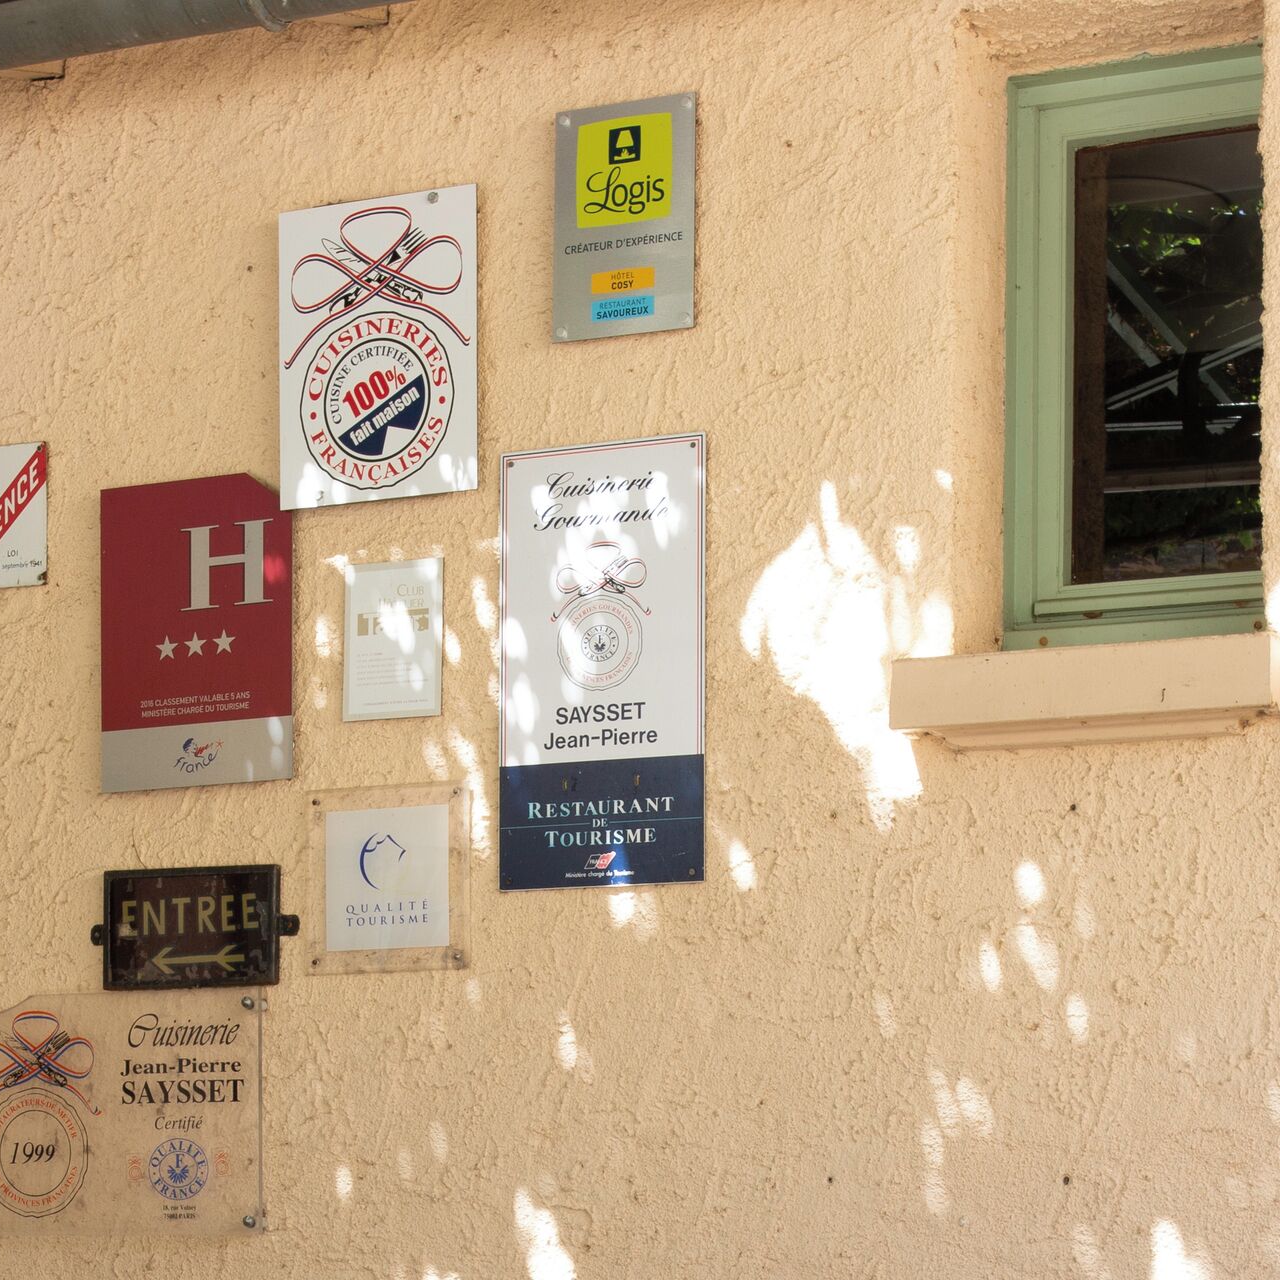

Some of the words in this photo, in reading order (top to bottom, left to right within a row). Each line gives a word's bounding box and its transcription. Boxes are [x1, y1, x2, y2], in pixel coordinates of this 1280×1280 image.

[583, 166, 665, 215] Logis
[564, 239, 613, 256] CRÉATEUR
[616, 231, 683, 250] D'EXPÉRIENCE
[610, 270, 635, 281] HÔTEL
[611, 279, 634, 290] COSY
[596, 306, 649, 320] SAVOUREUX
[599, 297, 646, 310] RESTAURANT
[308, 317, 448, 401] CUISINERIES
[330, 364, 352, 425] CUISINE
[350, 344, 414, 372] CERTIFIÉE
[342, 365, 407, 419] 100%
[349, 418, 374, 446] fait
[373, 386, 421, 428] maison
[311, 416, 444, 485] FRANÇAISES
[7, 549, 19, 558] LOI
[180, 518, 274, 612] H
[155, 695, 198, 707] CLASSEMENT
[199, 692, 230, 703] VALABLE
[230, 692, 235, 700] 5
[235, 690, 251, 700] ANS
[205, 704, 215, 713] DU
[216, 701, 250, 712] TOURISME
[555, 701, 646, 726] SAYSSET
[543, 727, 658, 751] Jean-Pierre
[527, 796, 675, 820] RESTAURANT
[592, 817, 609, 829] DE
[544, 827, 657, 849] TOURISME
[345, 898, 429, 916] QUALITÉ
[345, 913, 429, 928] TOURISME
[127, 1012, 241, 1049] Cuisinerie
[120, 1057, 242, 1077] Jean-Pierre
[121, 1078, 245, 1105] SAYSSET
[154, 1115, 204, 1133] Certifié
[9, 1141, 56, 1165] 1999
[153, 1179, 205, 1199] FRANCE
